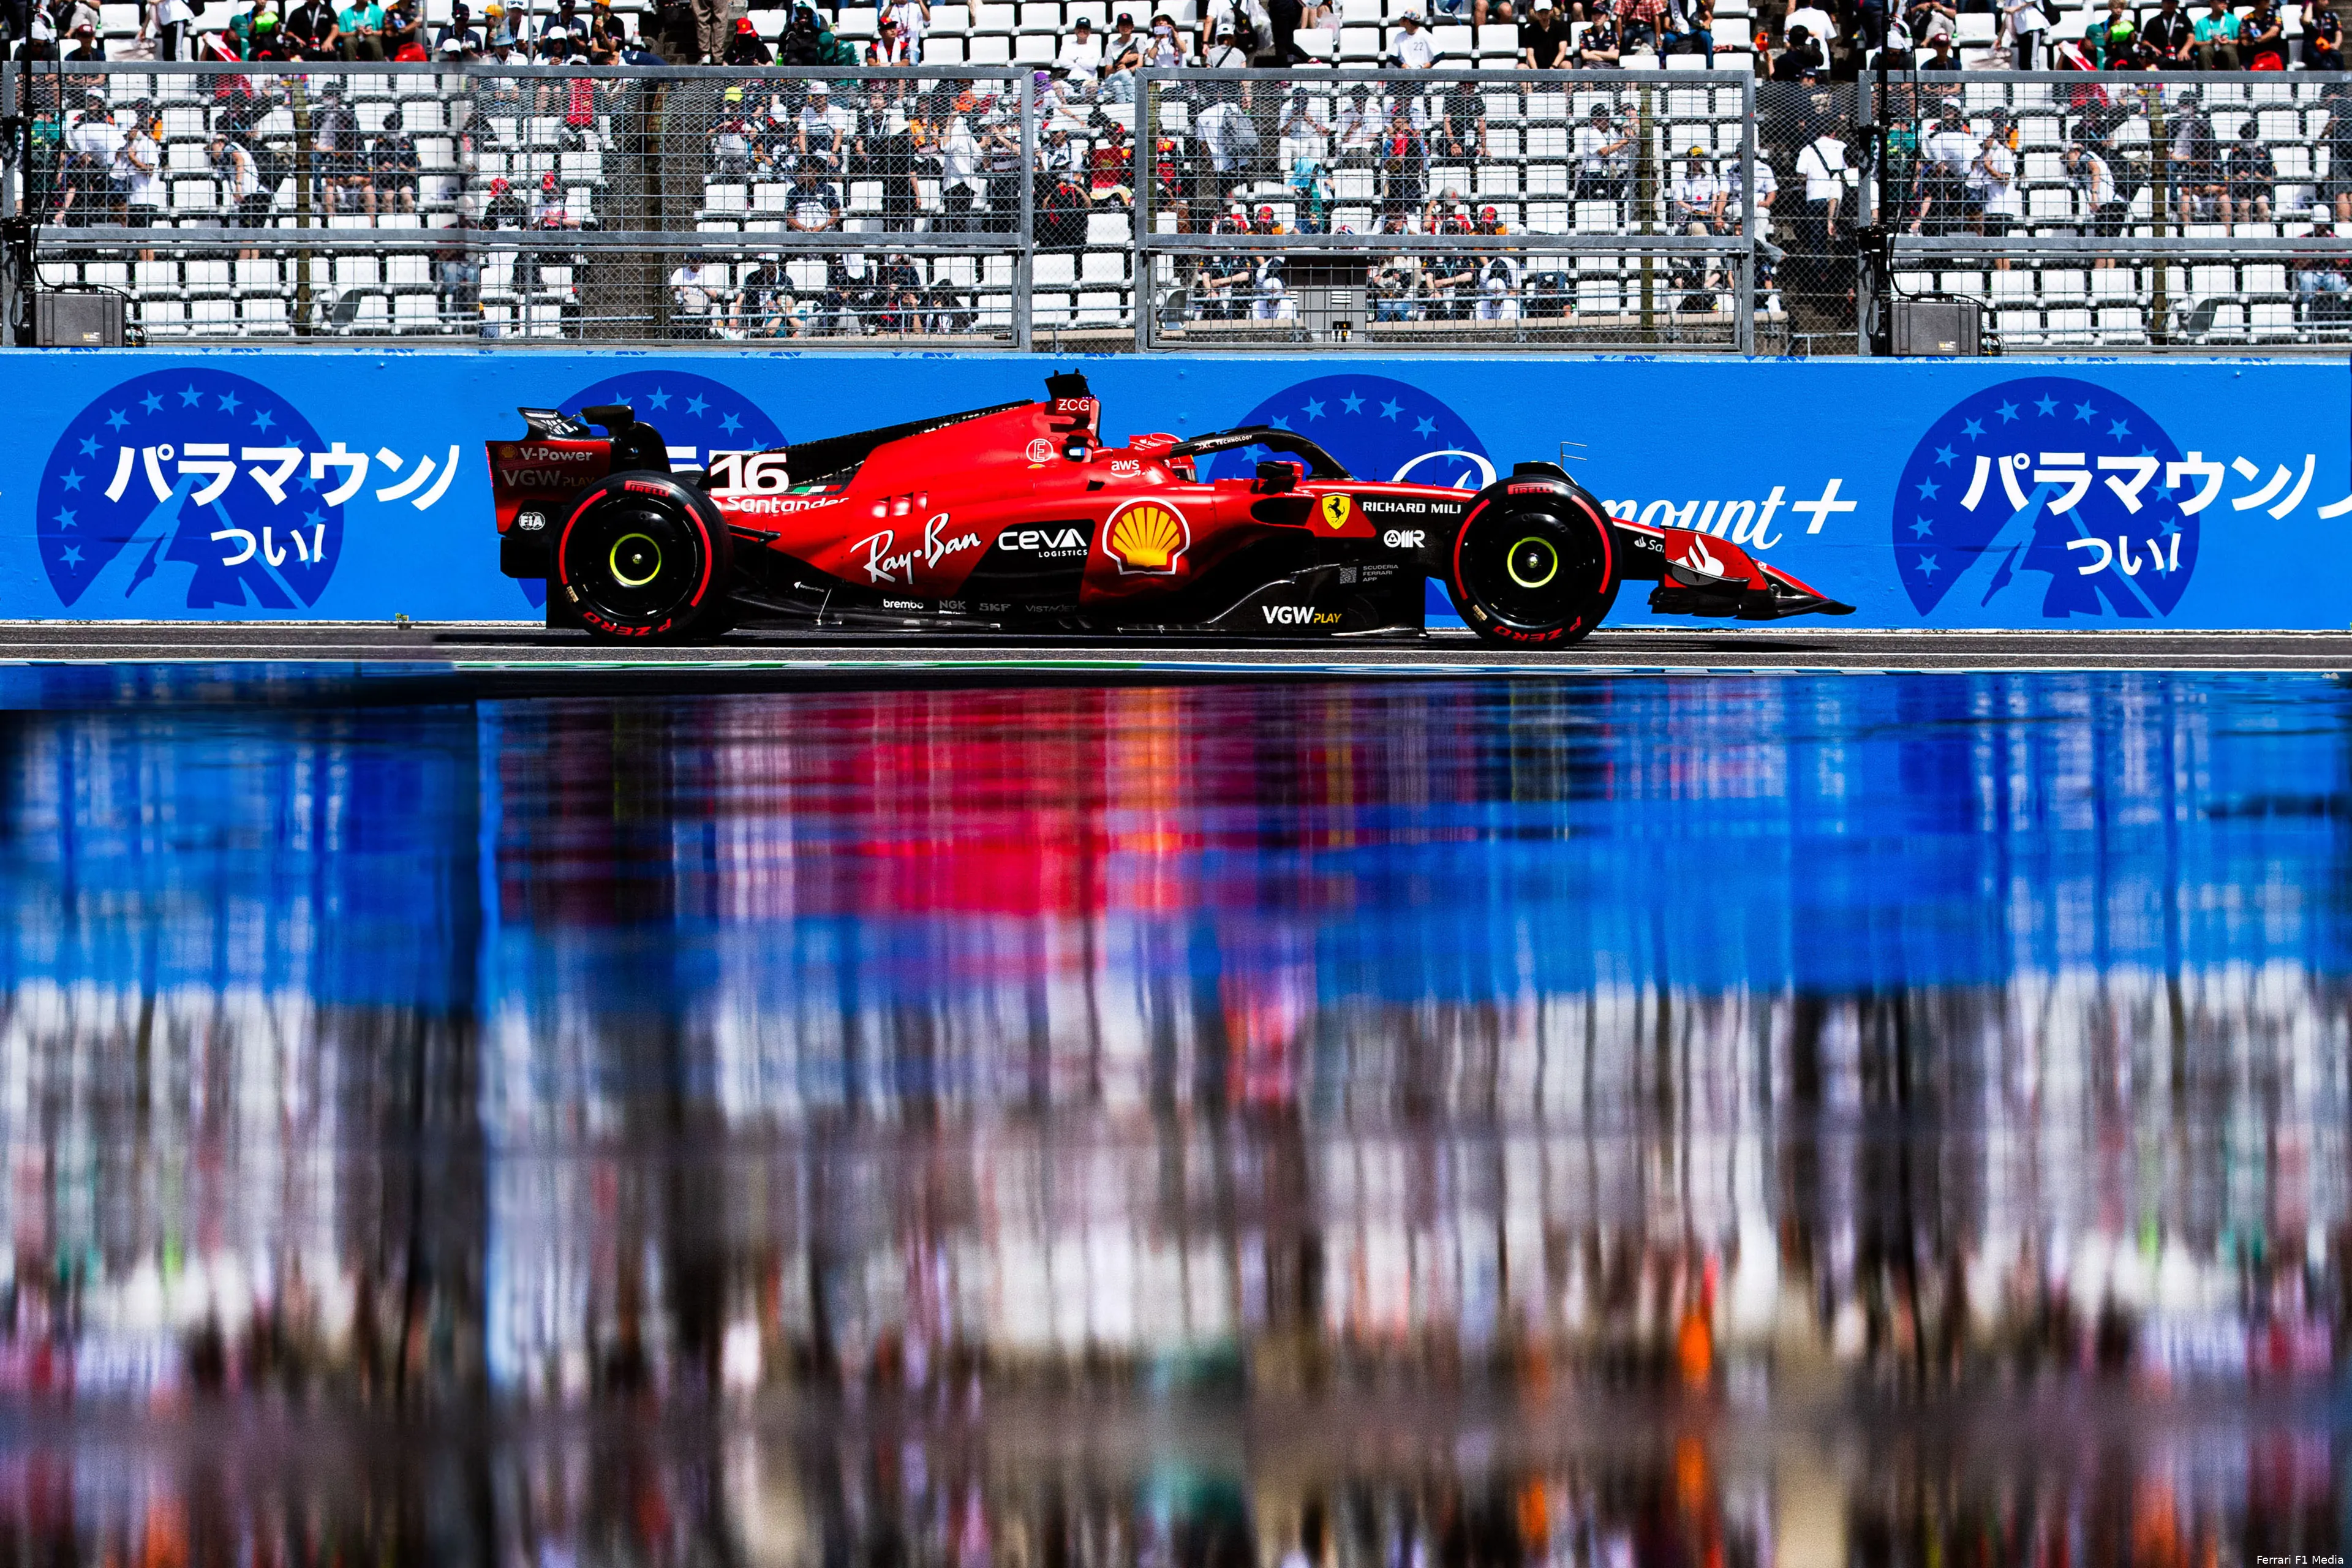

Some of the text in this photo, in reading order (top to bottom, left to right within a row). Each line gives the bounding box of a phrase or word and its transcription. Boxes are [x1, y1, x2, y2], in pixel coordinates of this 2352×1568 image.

[1414, 42, 1423, 51] 22
[1058, 399, 1090, 411] ZCG
[1194, 434, 1253, 451] DXC TECHNOLOGY
[520, 447, 593, 461] V-Power
[1111, 459, 1140, 471] aws
[502, 470, 595, 487] VGW PLAY
[710, 453, 790, 496] 16
[1508, 483, 1554, 495] PIRELLI
[725, 496, 850, 514] Santander
[1362, 502, 1426, 513] RICHARD
[998, 528, 1087, 551] CEVA
[883, 598, 924, 609] brembo
[939, 600, 967, 609] NGK
[979, 603, 1011, 612] SKF
[1262, 605, 1343, 624] VGW PLAY
[583, 612, 651, 636] ZERO
[1493, 625, 1562, 642] ZERO
